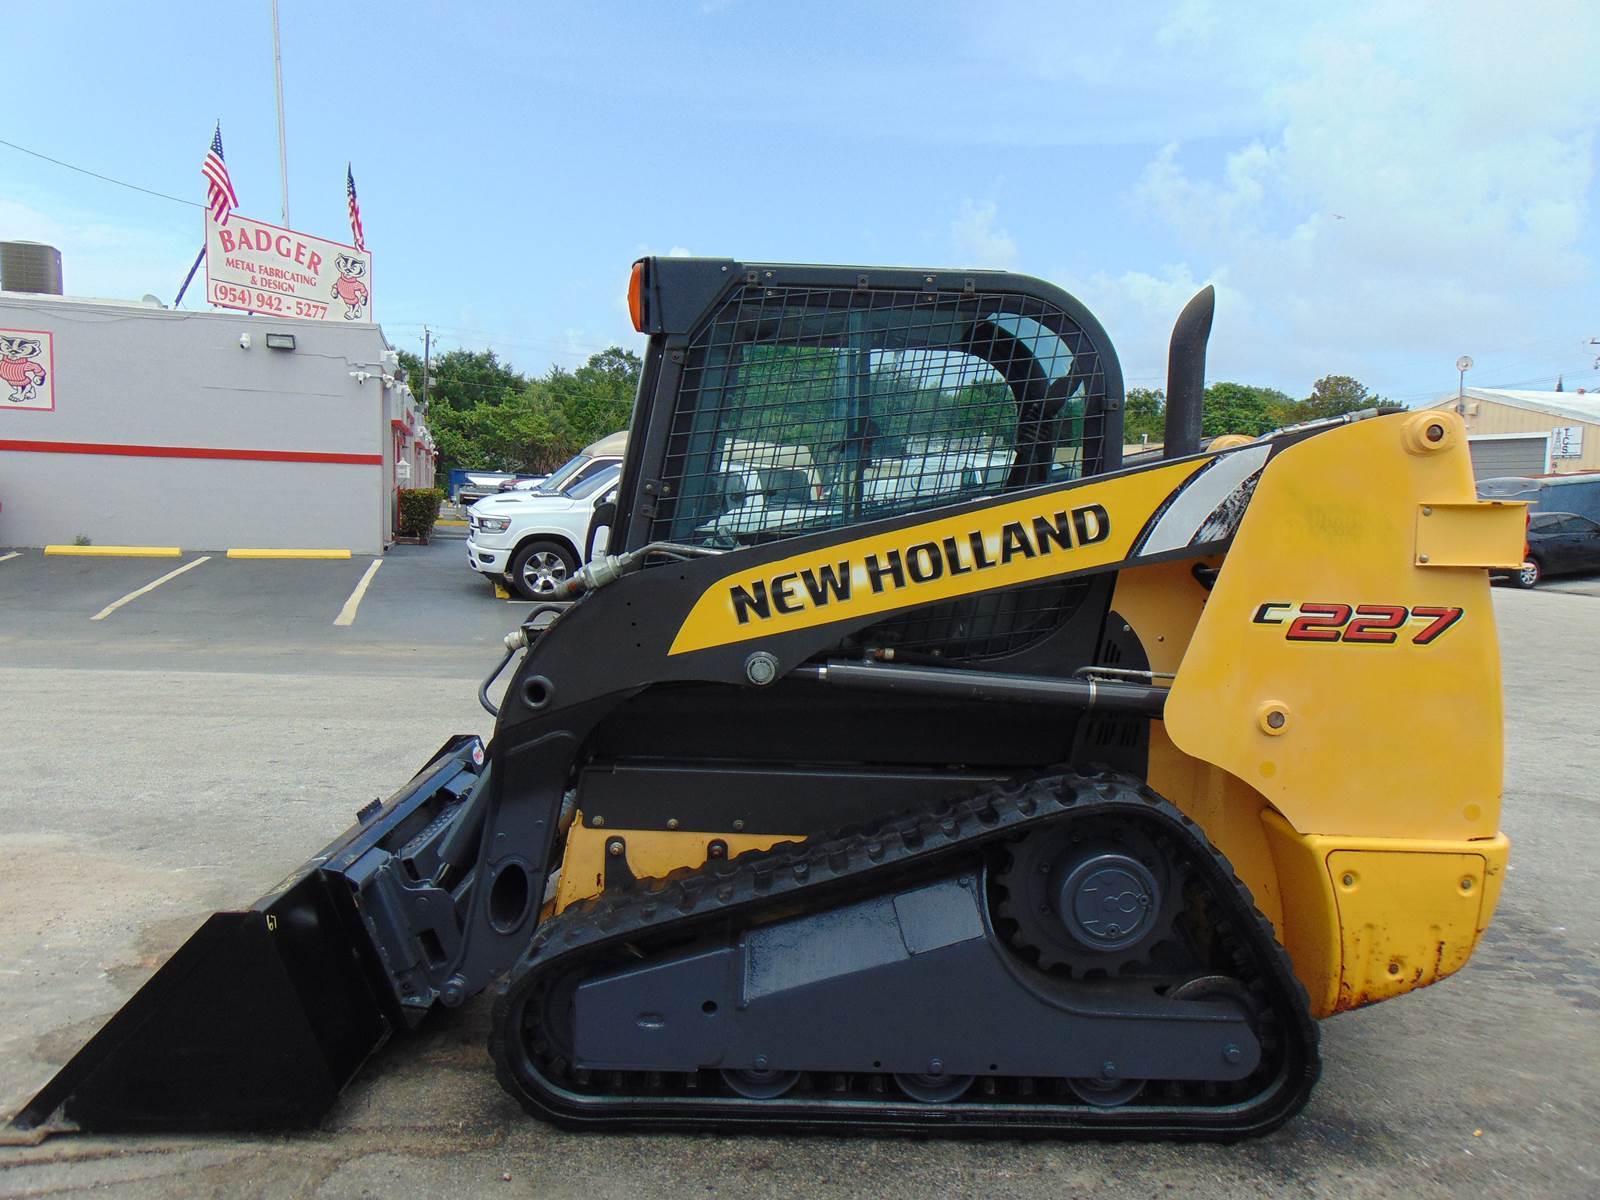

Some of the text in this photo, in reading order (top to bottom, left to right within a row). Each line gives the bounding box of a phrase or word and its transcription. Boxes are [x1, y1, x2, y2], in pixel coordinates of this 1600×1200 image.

[219, 227, 322, 276] BADGER
[225, 257, 317, 287] METAL FABRICATING
[250, 277, 295, 293] & DESIGN
[213, 283, 252, 306] (954)
[256, 293, 282, 312] 942
[295, 301, 328, 320] 5277
[729, 503, 1111, 625] NEW HOLLAND
[1252, 602, 1464, 645] C227
